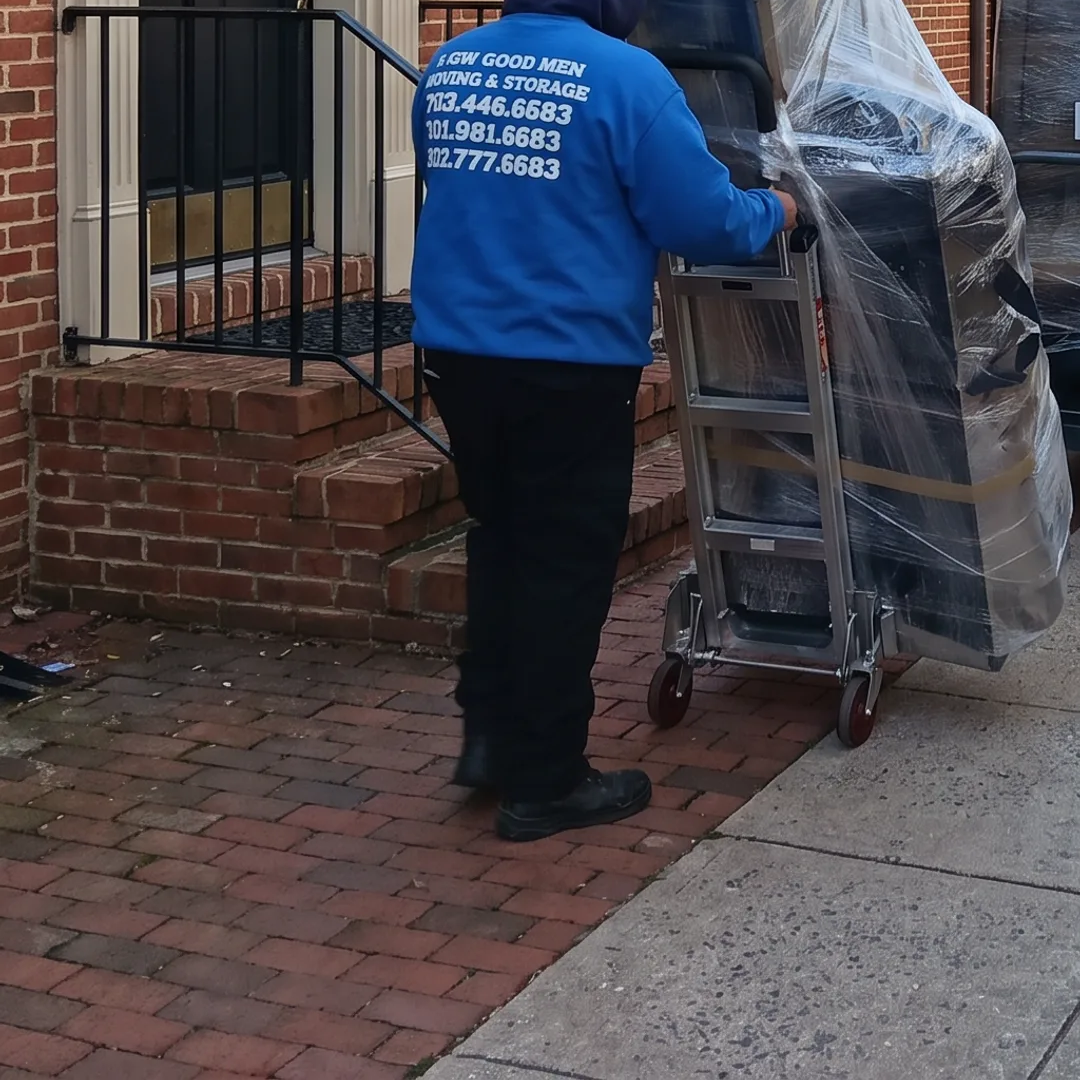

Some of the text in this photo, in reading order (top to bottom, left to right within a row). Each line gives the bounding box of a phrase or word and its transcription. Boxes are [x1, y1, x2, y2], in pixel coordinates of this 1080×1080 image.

[481, 53, 536, 70] GOOD
[537, 57, 588, 78] MEN
[425, 71, 591, 102] MOVING & STORAGE
[425, 119, 562, 152] 301.981.6683
